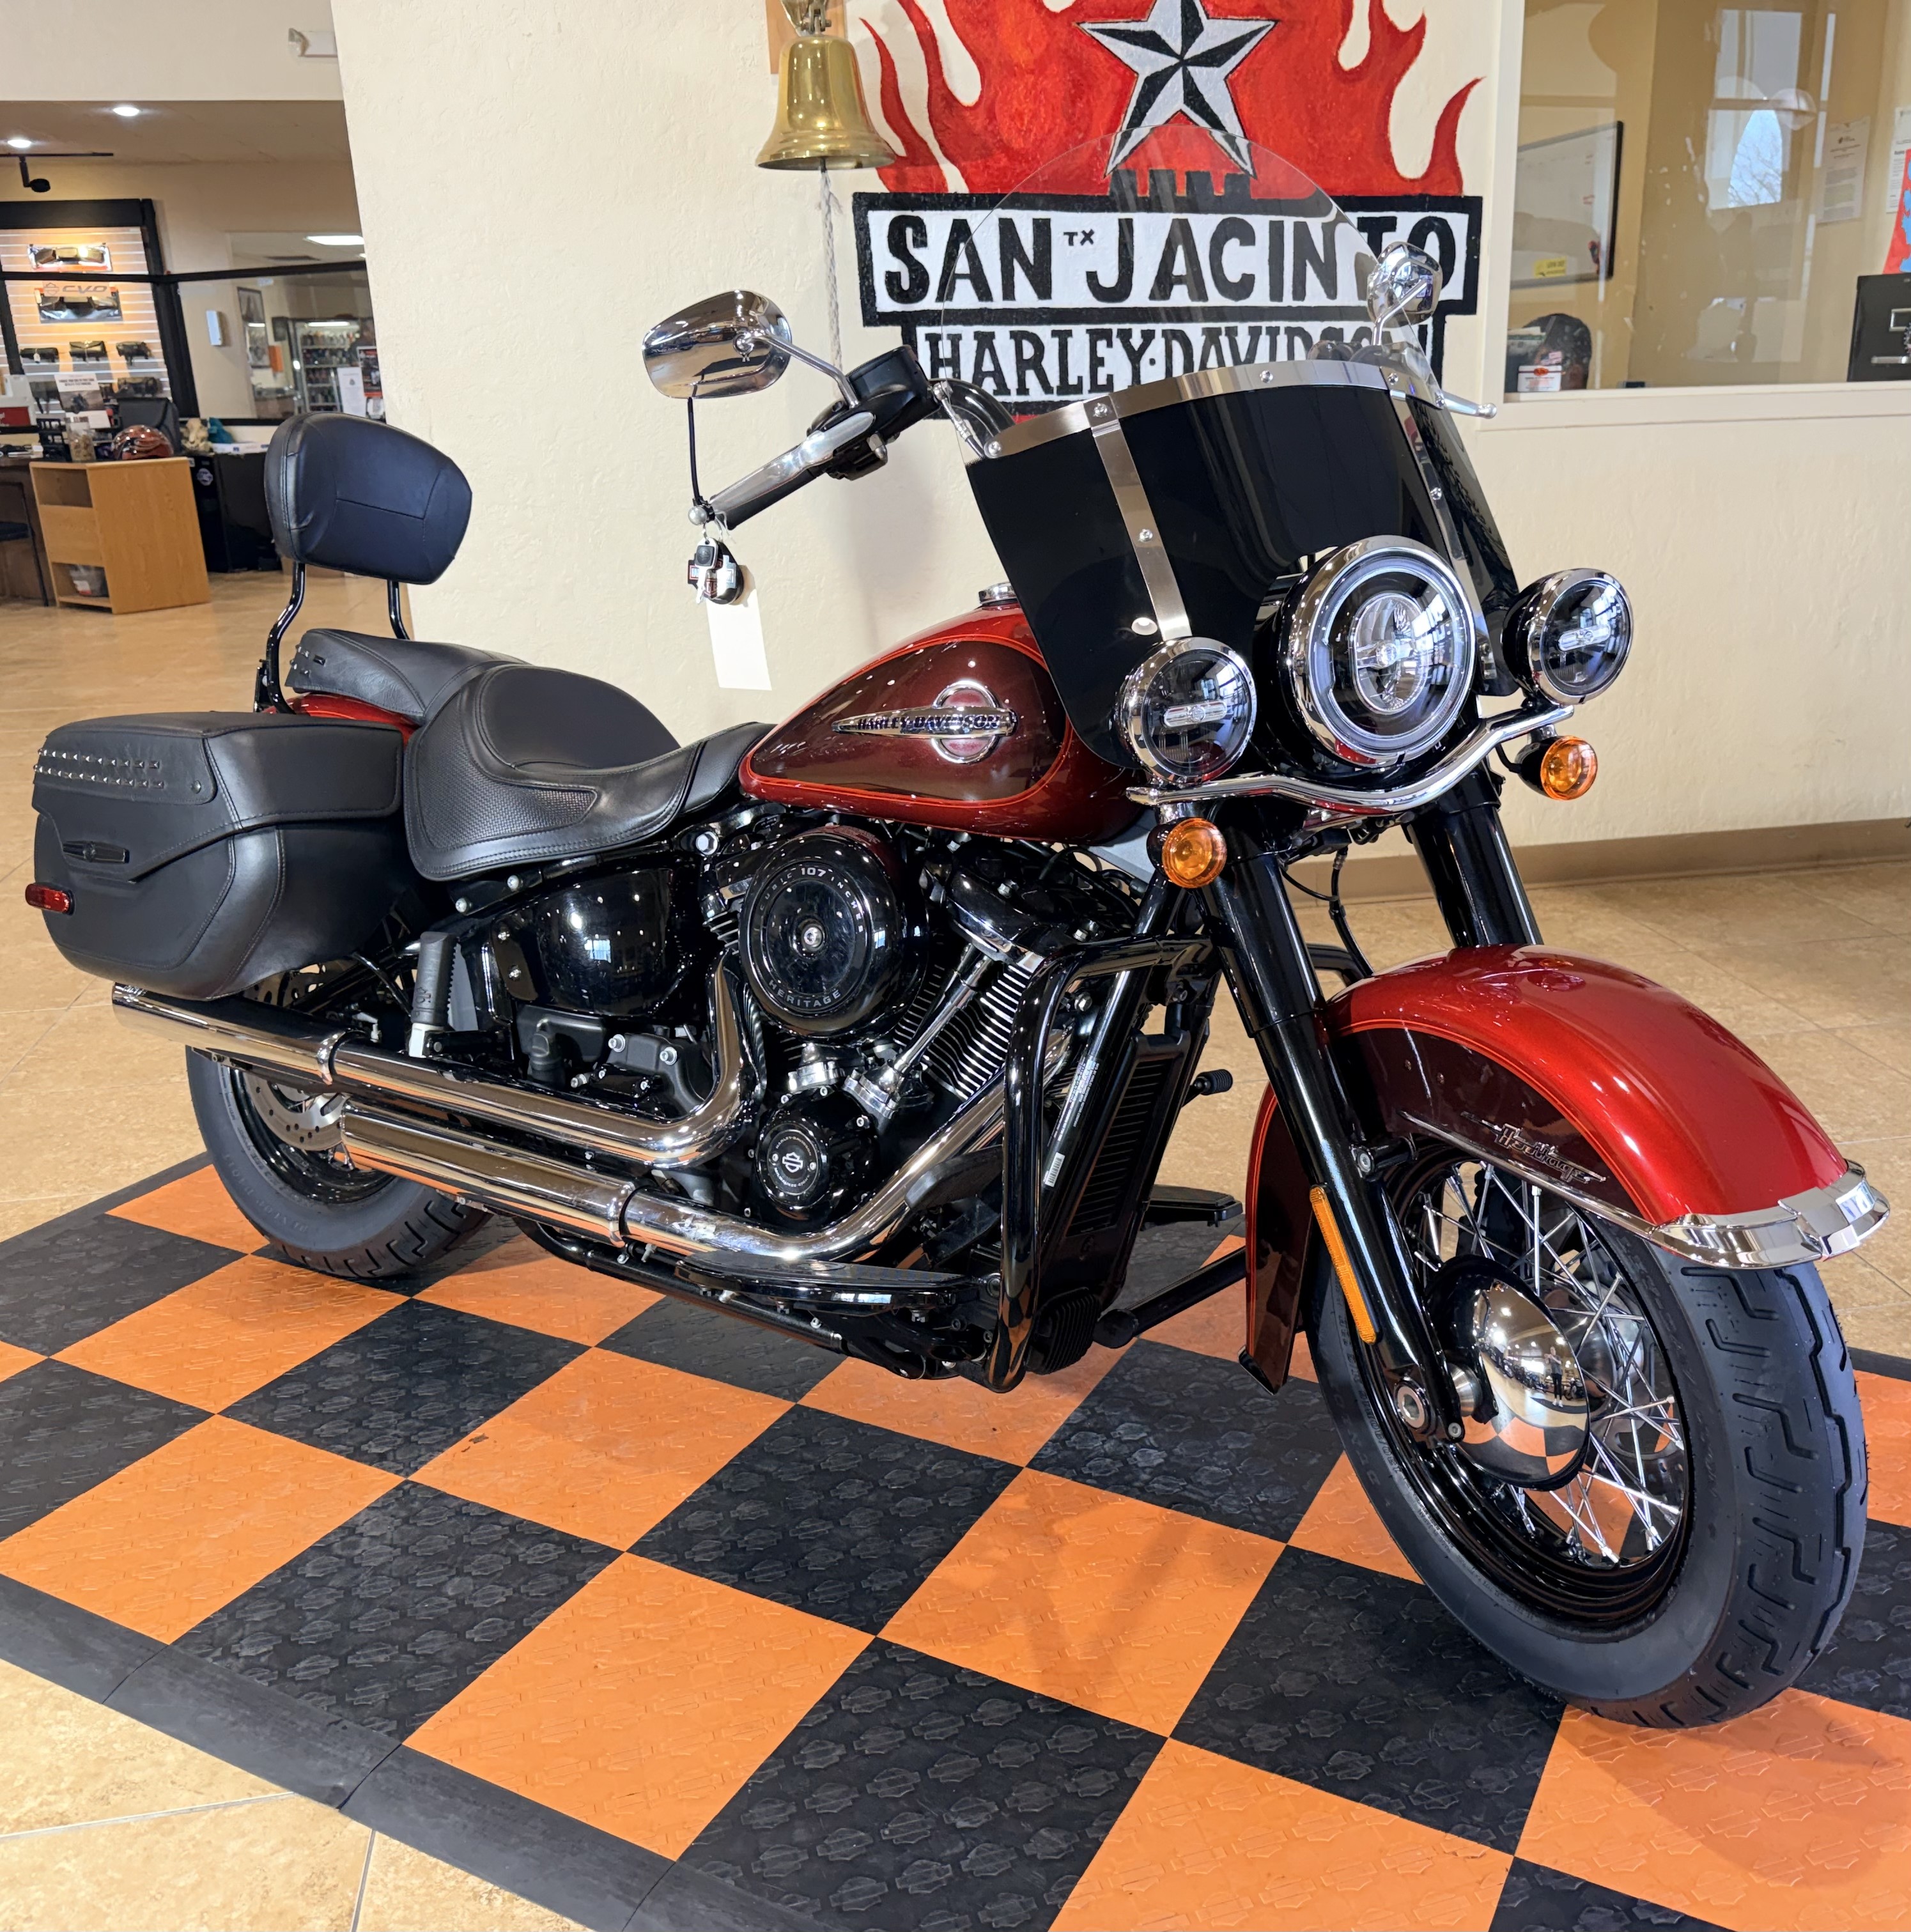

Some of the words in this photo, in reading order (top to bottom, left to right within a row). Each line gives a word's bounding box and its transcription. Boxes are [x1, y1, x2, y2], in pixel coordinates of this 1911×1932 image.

[885, 215, 1052, 304] SAN
[1064, 229, 1094, 246] TX
[62, 285, 107, 294] CVO
[801, 866, 826, 877] 107
[769, 979, 841, 1008] HERITAGE
